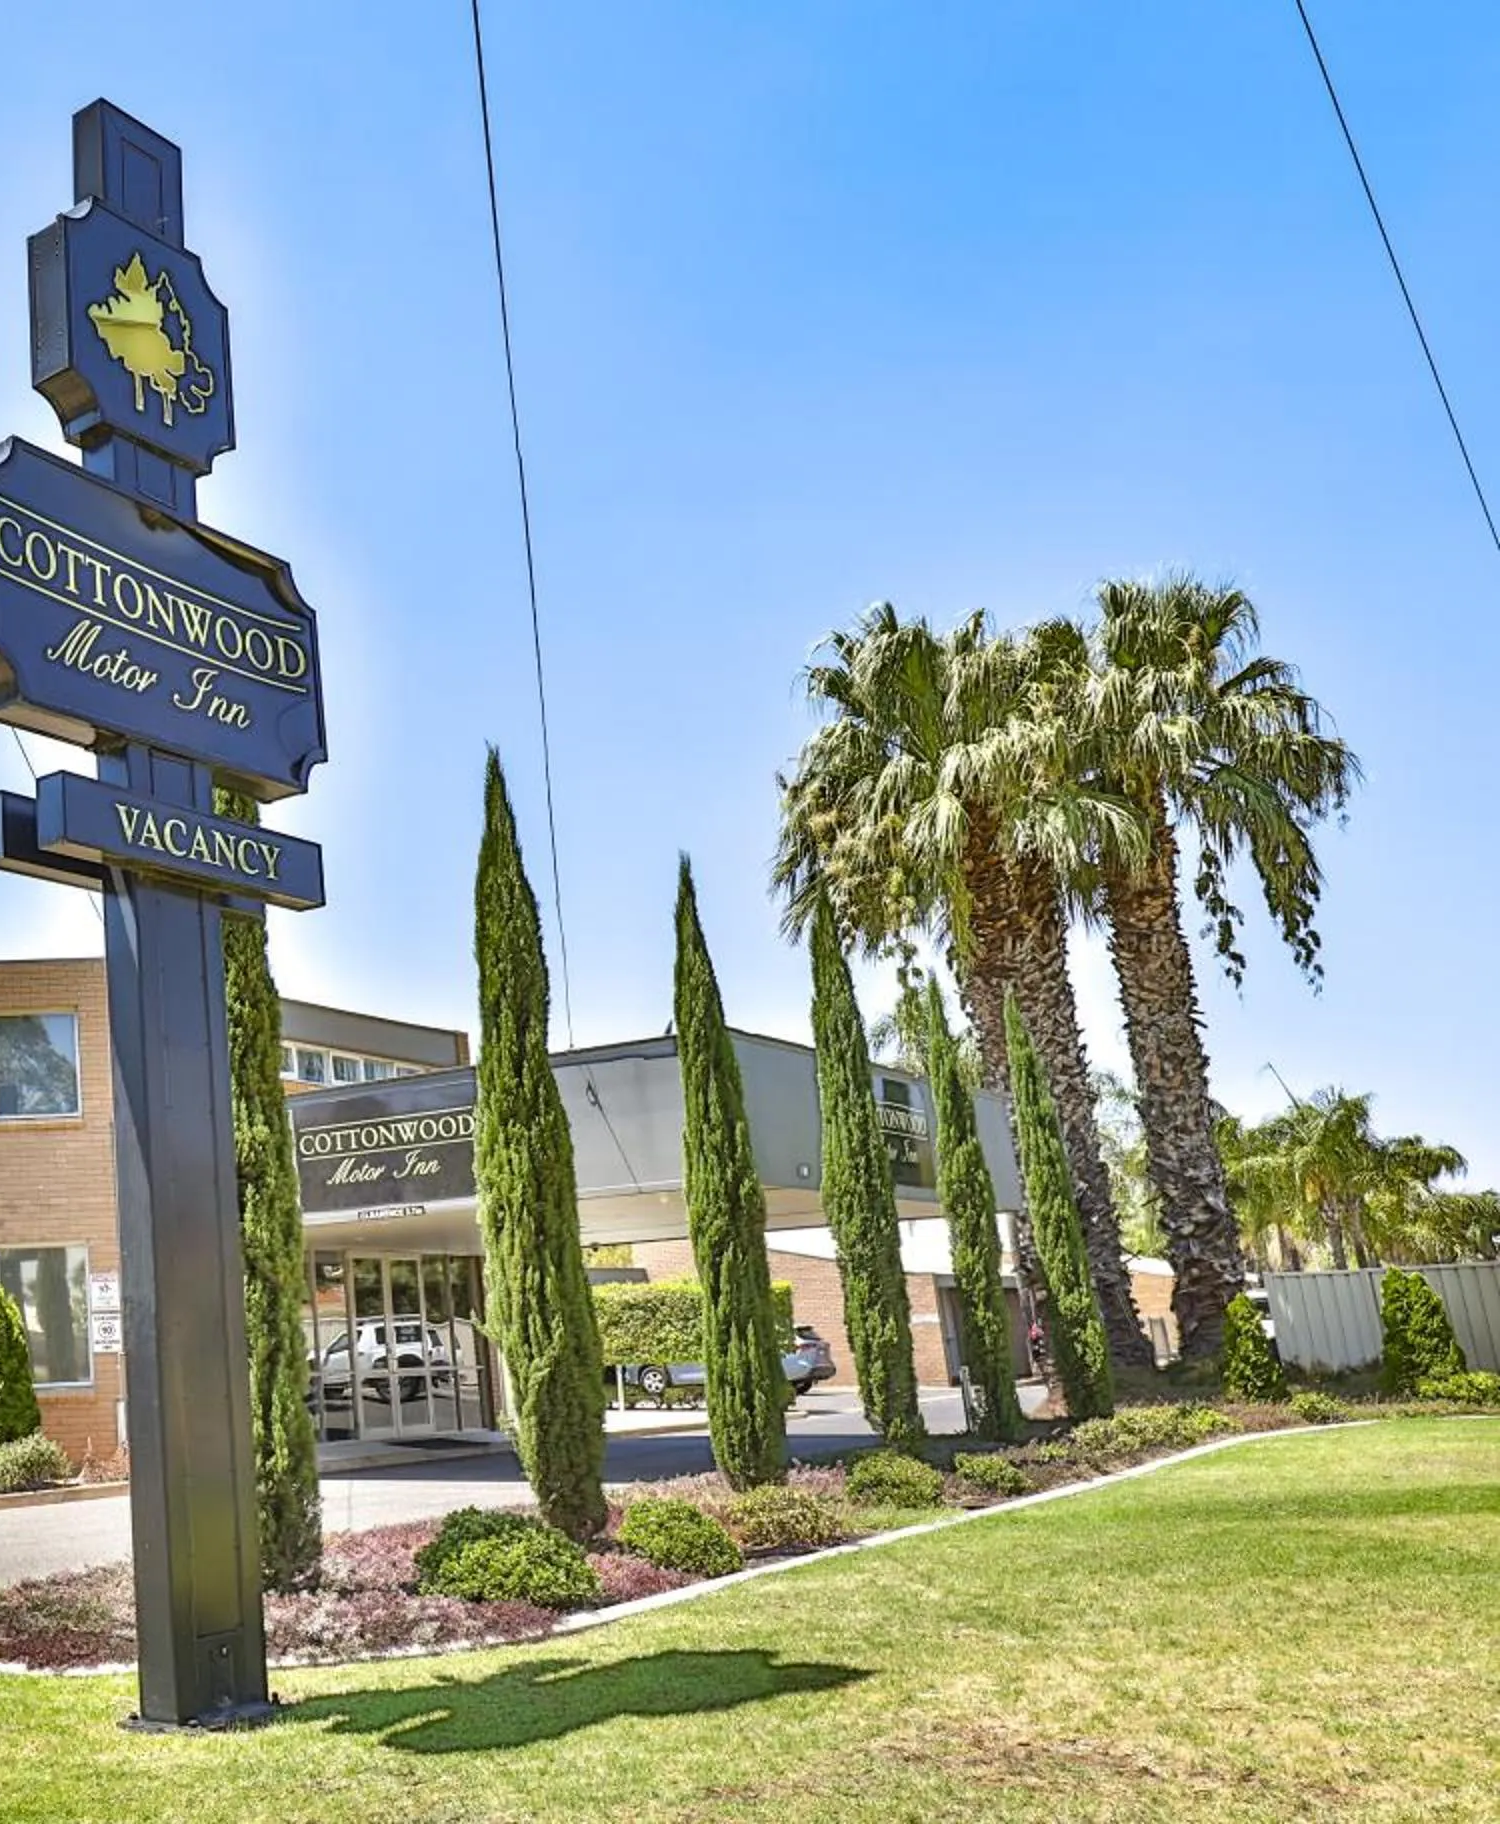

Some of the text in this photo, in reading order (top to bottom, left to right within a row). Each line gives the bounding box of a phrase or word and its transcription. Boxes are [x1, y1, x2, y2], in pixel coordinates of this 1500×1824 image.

[46, 619, 251, 730] Motor Inn
[115, 803, 283, 881] VACANCY
[300, 1115, 475, 1155] COTTONWOOD
[326, 1149, 441, 1185] Motor Inn
